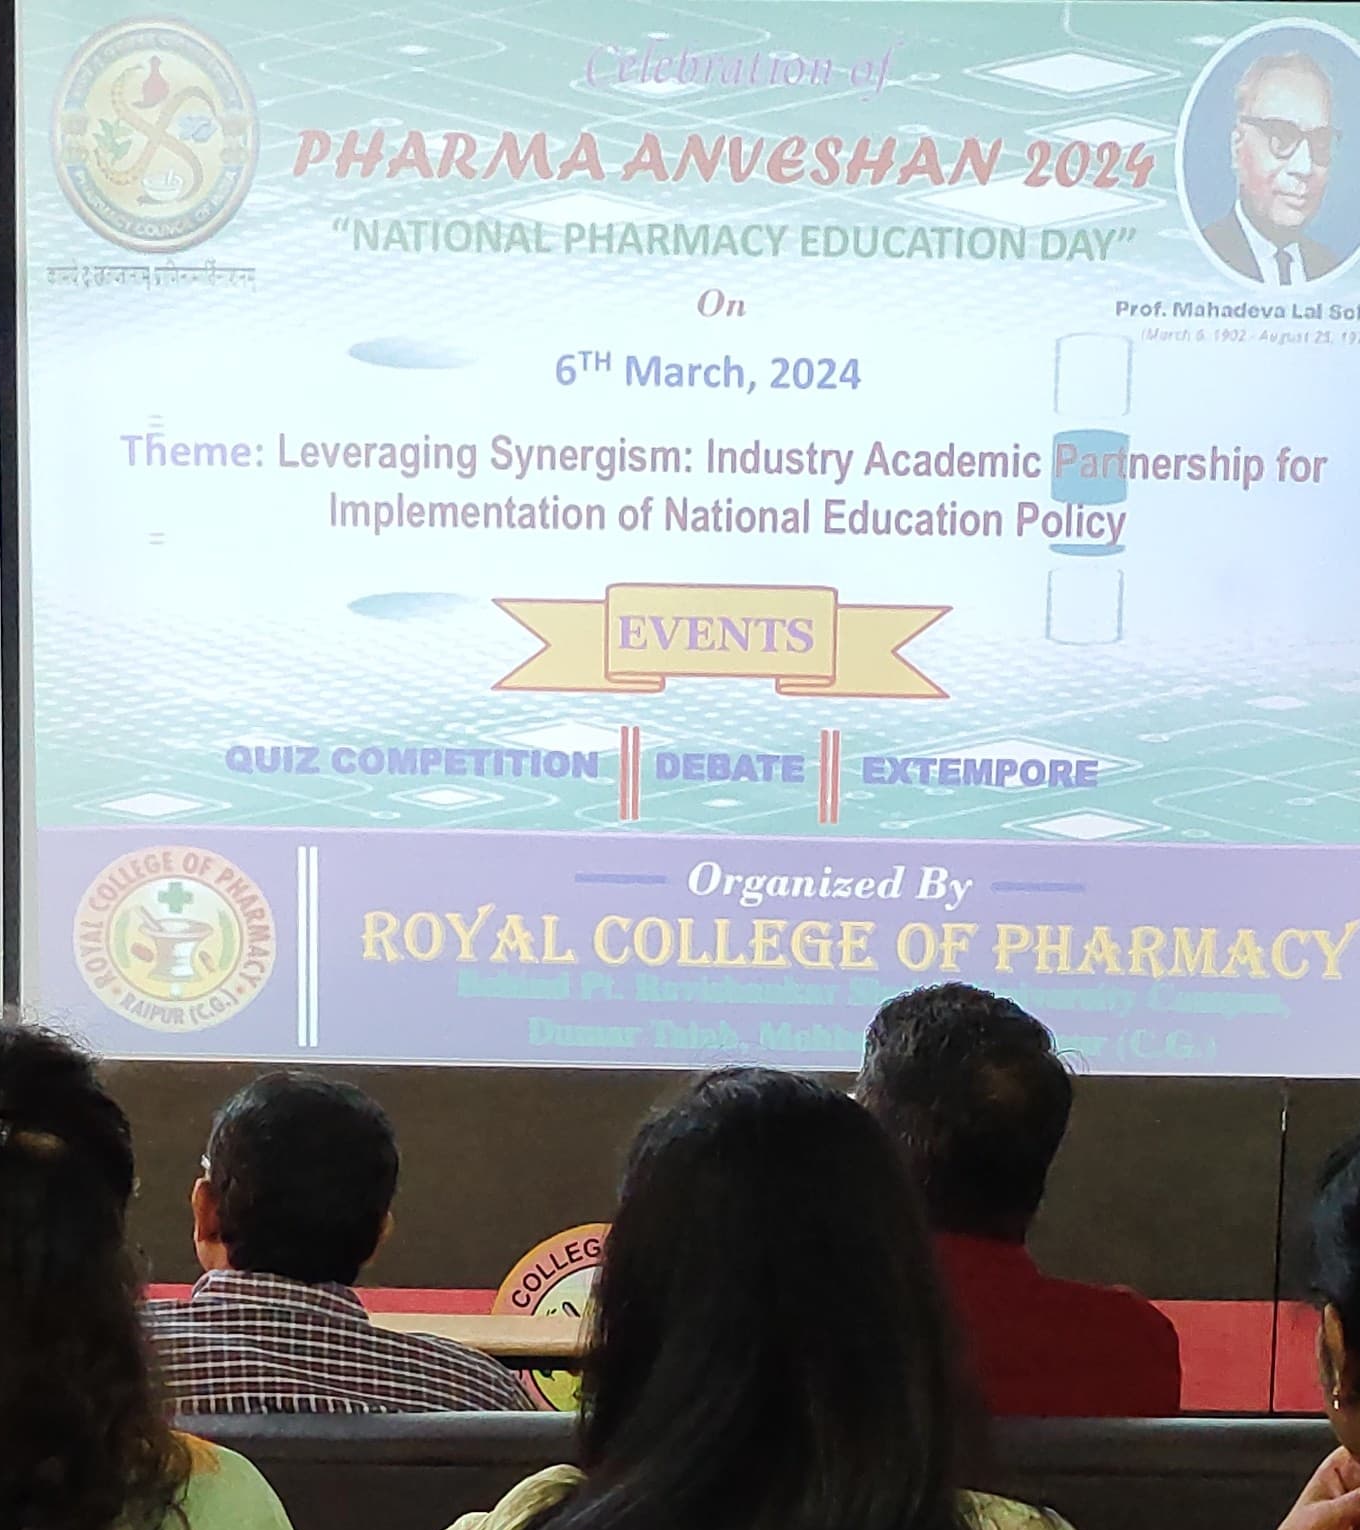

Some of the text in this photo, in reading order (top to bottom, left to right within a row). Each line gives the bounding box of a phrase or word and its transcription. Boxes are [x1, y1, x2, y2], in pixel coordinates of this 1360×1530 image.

[586, 38, 903, 102] Celebration of
[293, 129, 1157, 188] PHARMA ANVESHAN 2024
[565, 223, 789, 258] PHARMACY
[800, 226, 1027, 260] EDUCATION
[697, 289, 747, 317] On
[1116, 301, 1166, 318] Prof.
[1172, 302, 1285, 320] Mahadeva
[1292, 303, 1322, 320] Lal
[554, 350, 863, 396] 6TH March, 2024
[120, 432, 1328, 488] Theme: Leveraging Synergism: Industry Academic Partnership for
[330, 492, 1126, 546] Implementation of National Education Policy
[618, 614, 814, 654] EVENTS
[226, 745, 1098, 789] QUIZ COMPETITION DEBATE EXTEMPORE
[687, 860, 974, 910] Organized By
[363, 903, 576, 965] ROYAL
[593, 914, 875, 972] COLLEGE
[897, 923, 979, 974] OF
[512, 1238, 600, 1308] COLLEG
